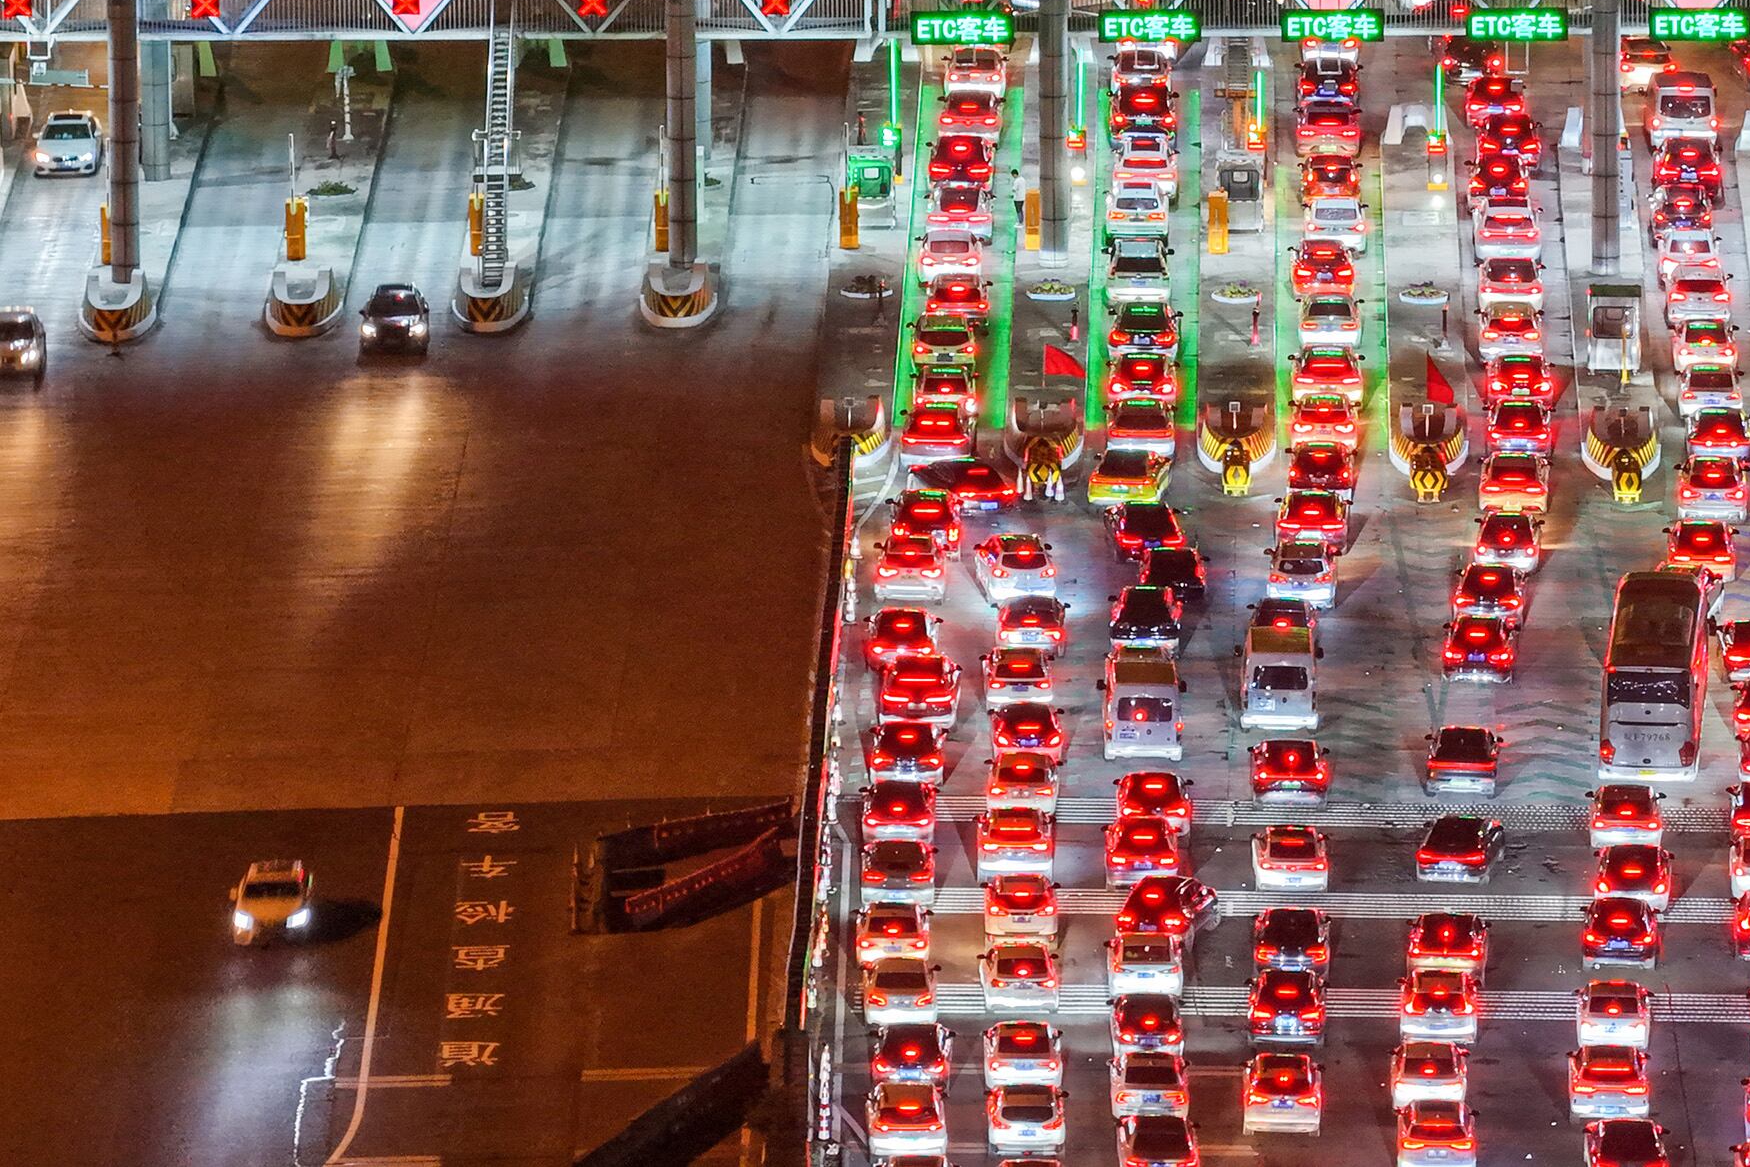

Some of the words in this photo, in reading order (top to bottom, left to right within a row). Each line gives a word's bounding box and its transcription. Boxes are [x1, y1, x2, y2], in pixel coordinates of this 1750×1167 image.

[917, 15, 1009, 41] ETC客车
[1104, 13, 1195, 39] ETC客车
[1287, 13, 1379, 39] ETC客车
[1471, 12, 1563, 38] ETC客车
[1654, 12, 1746, 38] ETC客车
